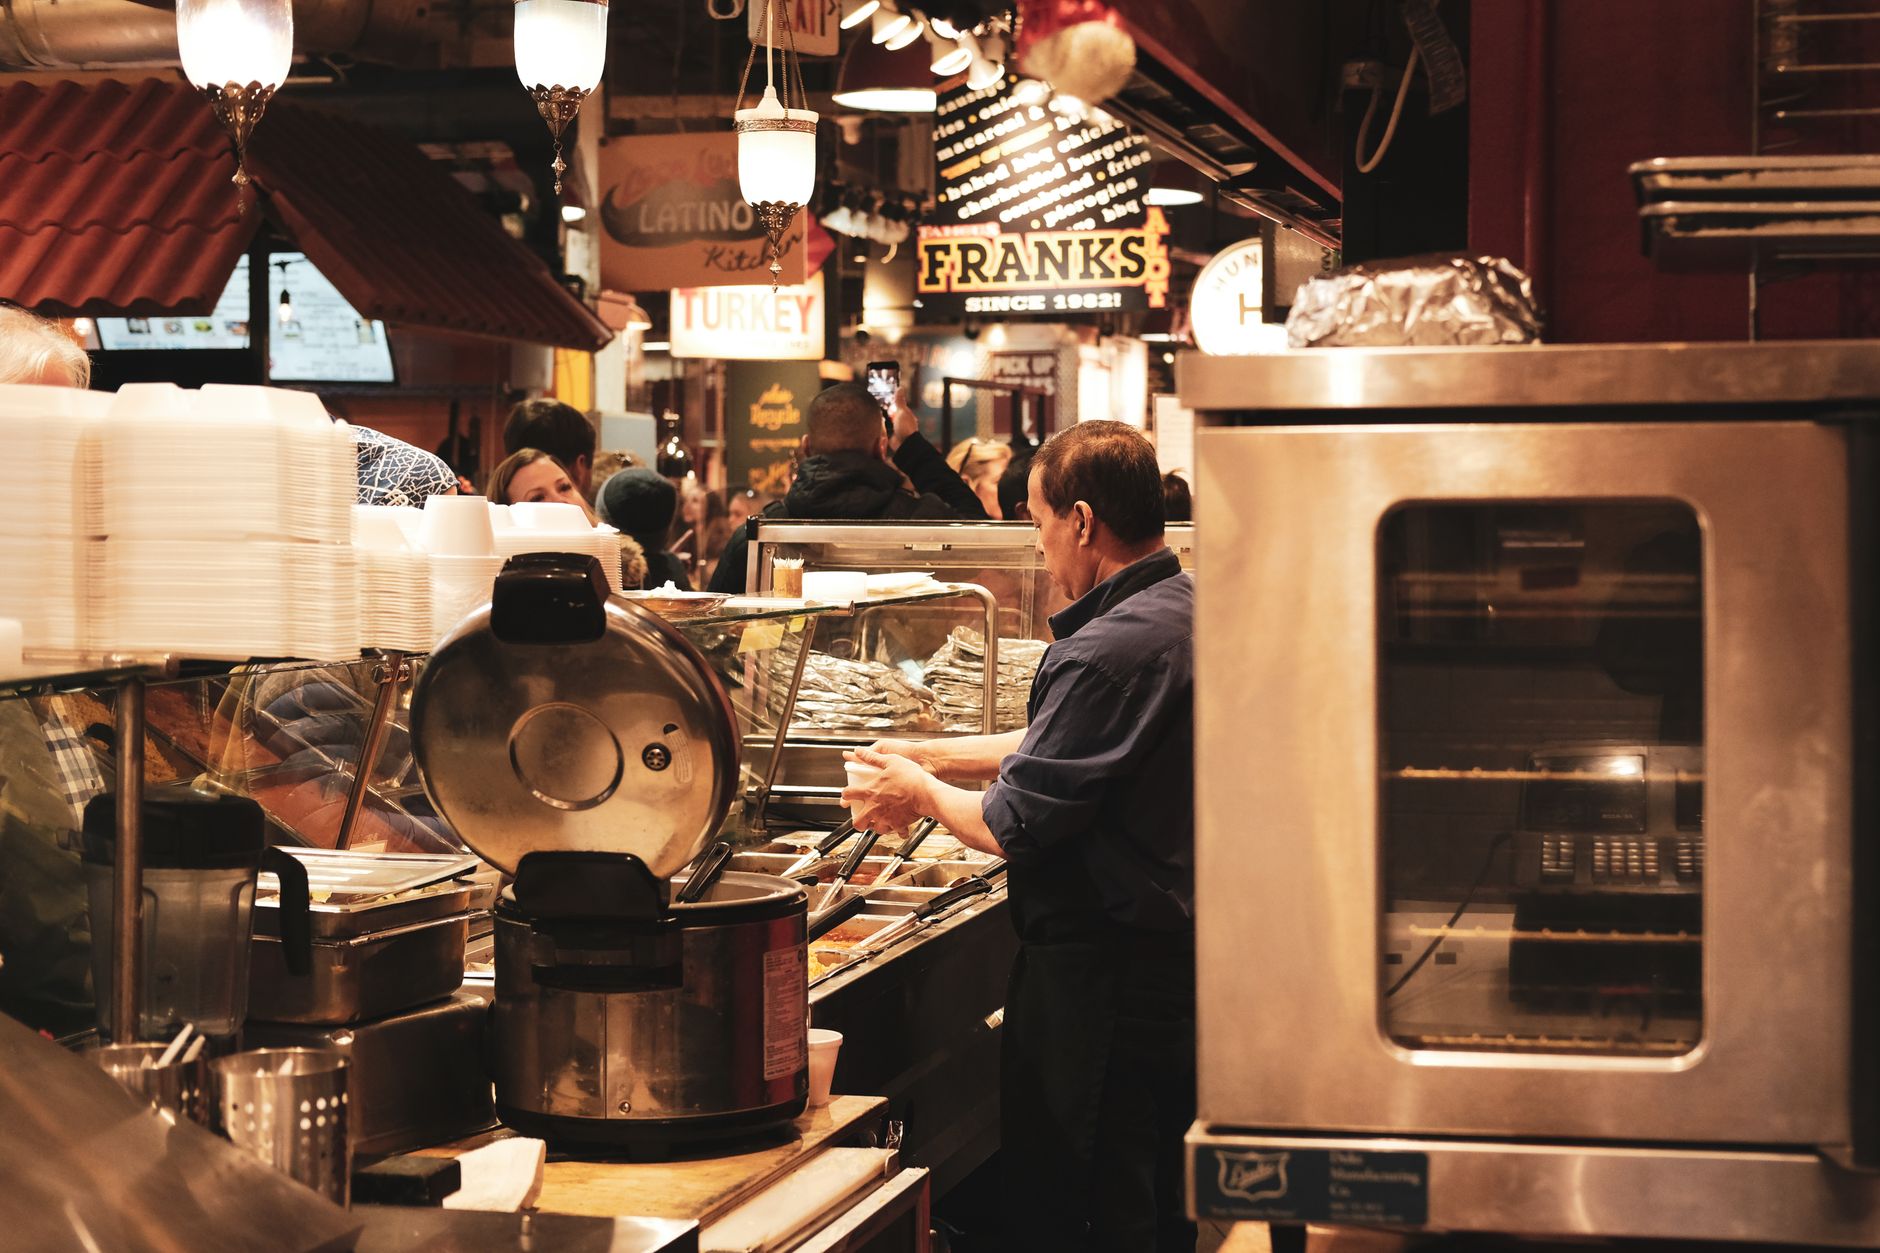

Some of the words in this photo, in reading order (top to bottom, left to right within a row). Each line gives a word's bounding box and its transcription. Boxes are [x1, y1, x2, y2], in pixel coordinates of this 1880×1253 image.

[639, 201, 754, 233] LATINO
[922, 234, 1147, 287] FRANKS
[679, 288, 816, 335] TURKEY
[965, 295, 1046, 312] SINCE
